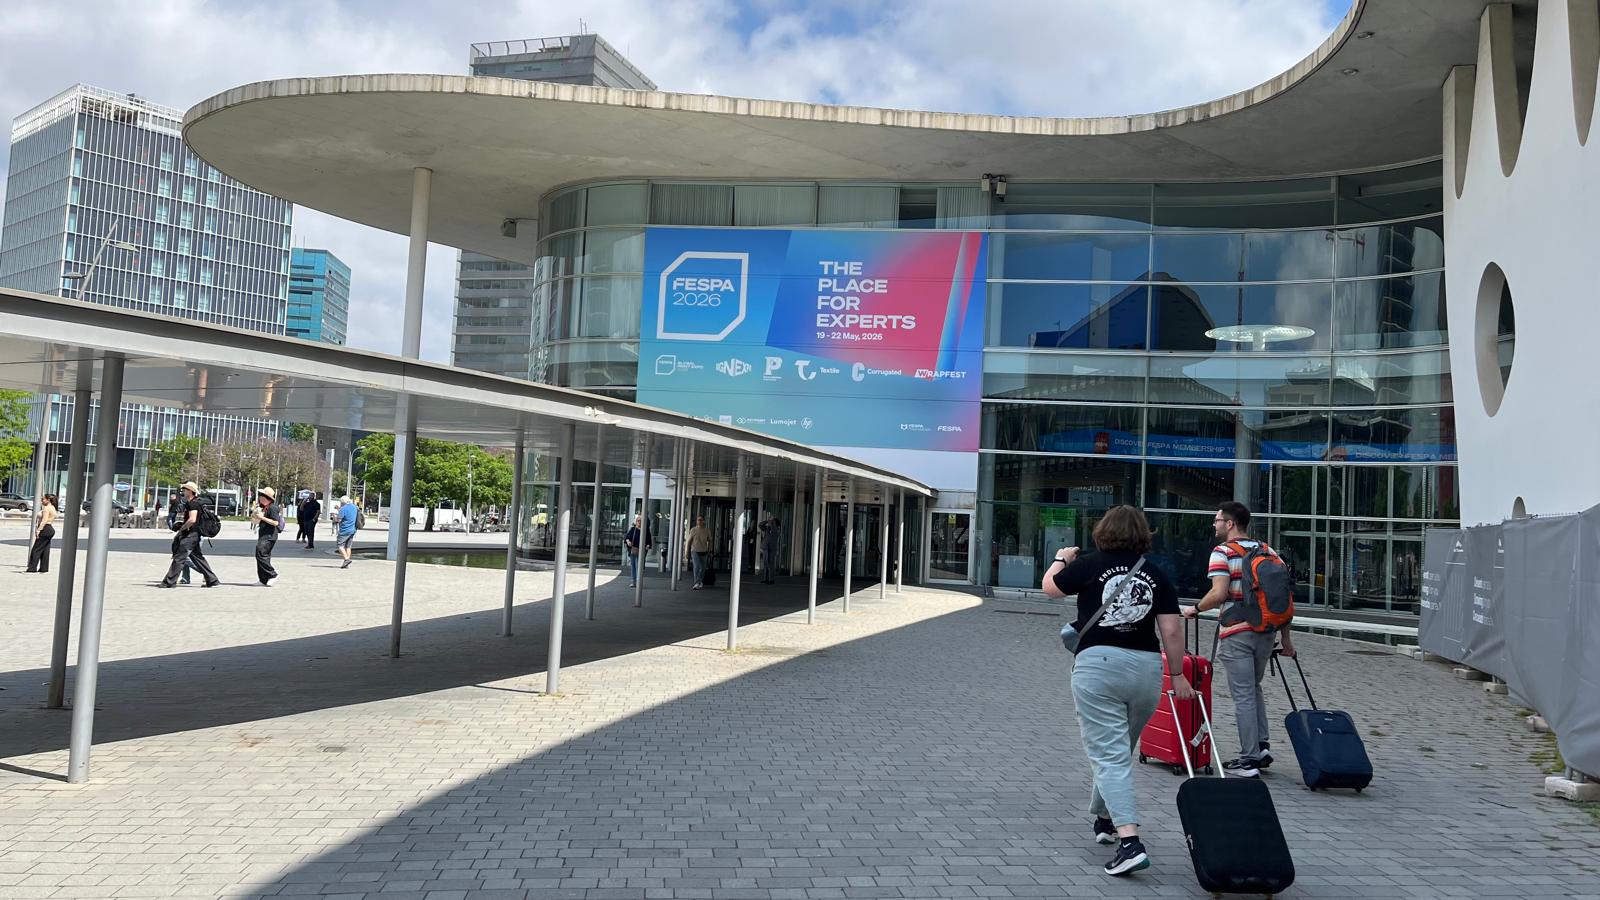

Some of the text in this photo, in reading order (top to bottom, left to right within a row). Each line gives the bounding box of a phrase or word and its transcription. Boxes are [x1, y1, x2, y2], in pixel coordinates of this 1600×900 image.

[818, 261, 863, 275] THE
[672, 278, 735, 292] FESPA
[818, 278, 888, 293] PLACE
[672, 292, 721, 307] 2026
[817, 295, 860, 311] FOR
[816, 313, 916, 329] EXPERTS
[843, 332, 861, 341] May,
[862, 333, 883, 341] 2026
[867, 368, 901, 376] Corrugated
[770, 418, 797, 426] Lumojet
[1114, 438, 1145, 448] DISCOVE
[1147, 441, 1171, 450] FESPA
[1172, 443, 1225, 454] MEMBERSHIP
[1098, 566, 1129, 582] ENDLESS
[1135, 570, 1157, 588] UMMER
